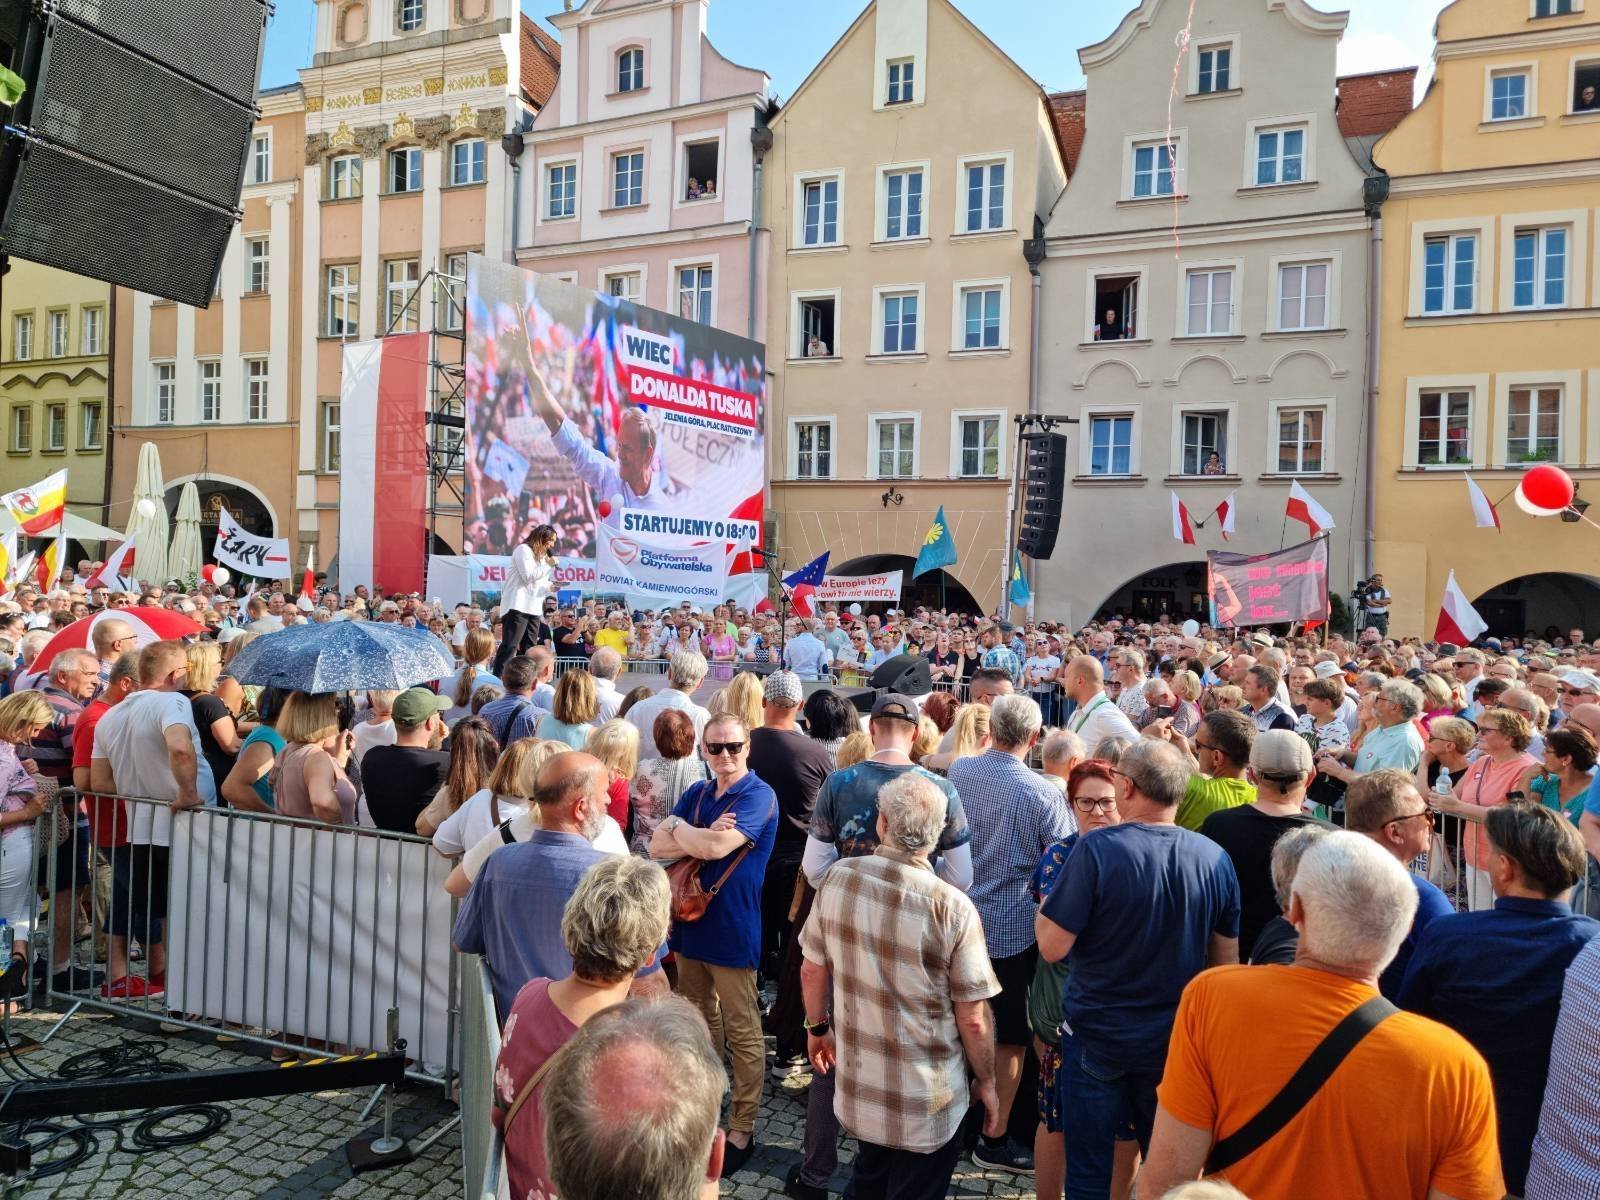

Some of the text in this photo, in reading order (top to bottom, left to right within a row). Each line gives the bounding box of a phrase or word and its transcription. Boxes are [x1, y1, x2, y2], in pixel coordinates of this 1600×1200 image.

[626, 334, 671, 366] WIEC
[631, 372, 753, 420] DONALDA TUSKA
[664, 411, 687, 423] JELENIA
[706, 420, 721, 431] PLAC
[720, 424, 753, 437] RATUSZOWY
[624, 513, 713, 537] STARTUJEMY
[714, 521, 724, 538] O
[221, 527, 271, 566] ŻARY
[640, 549, 699, 562] Platforma
[554, 563, 596, 581] GÓRA
[640, 556, 713, 572] Obywatelska
[600, 573, 718, 597] POWIAT KAMIENNOGÓRSKI
[830, 577, 867, 589] Europie
[863, 586, 897, 599] wierzy.
